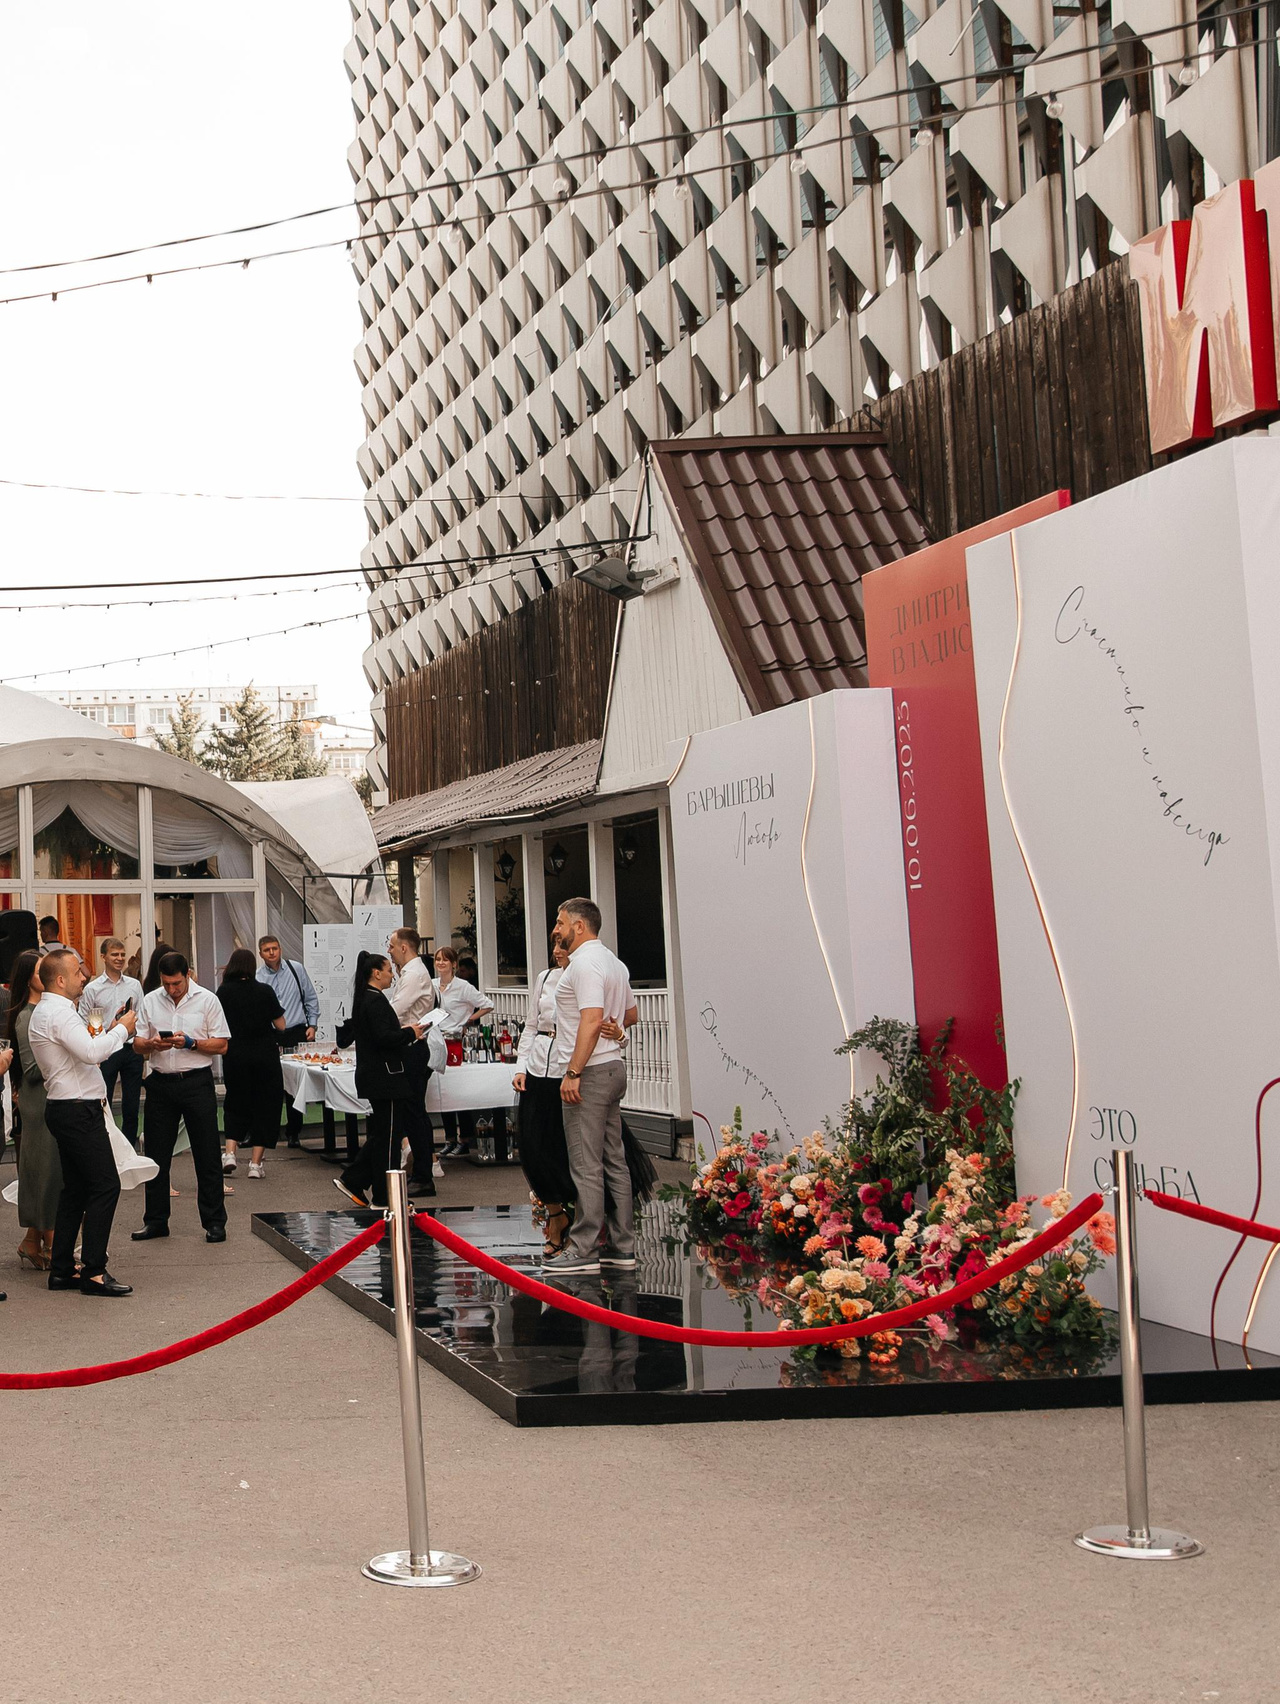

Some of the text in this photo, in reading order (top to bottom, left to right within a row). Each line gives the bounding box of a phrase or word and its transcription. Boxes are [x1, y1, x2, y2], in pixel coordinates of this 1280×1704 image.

[686, 772, 775, 816] БАРЫШЕВЫ
[896, 700, 923, 892] 10.06.2023
[1151, 774, 1232, 867] навсегда
[733, 810, 782, 866] Любовь
[1089, 1105, 1137, 1145] ЭТО
